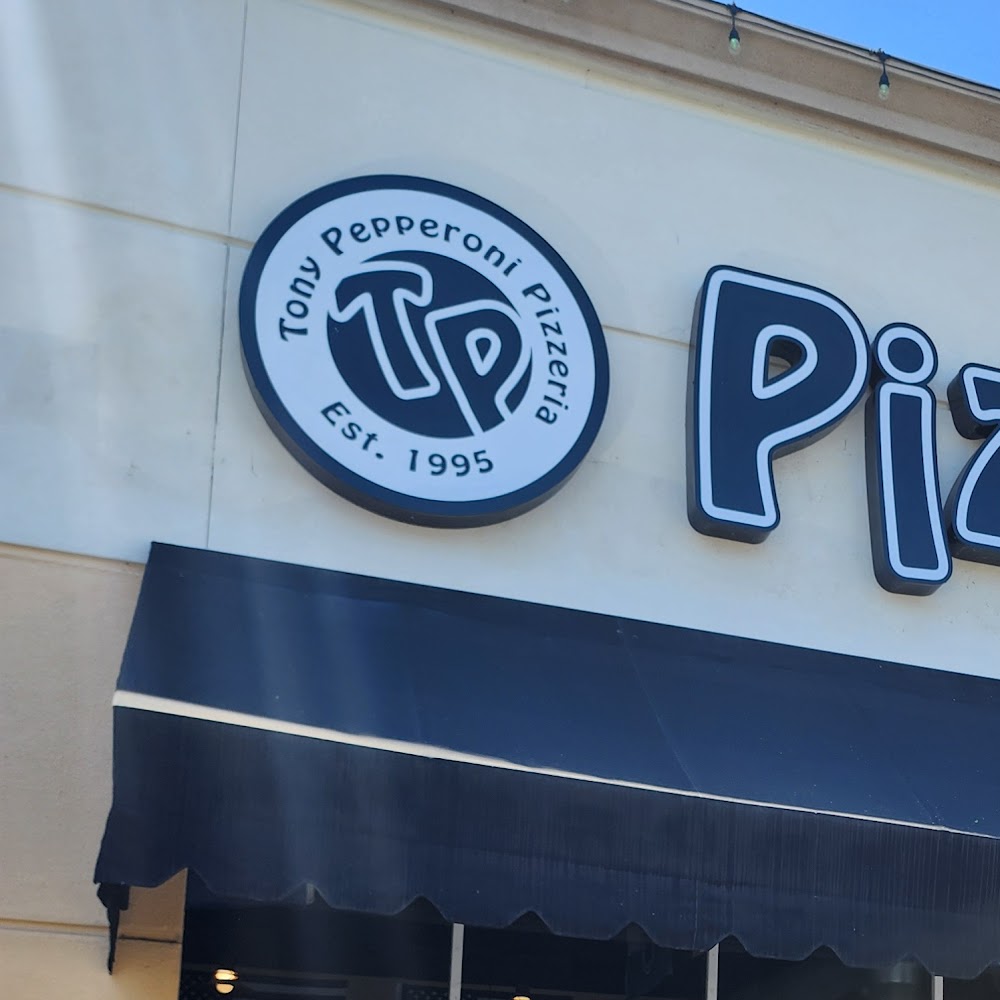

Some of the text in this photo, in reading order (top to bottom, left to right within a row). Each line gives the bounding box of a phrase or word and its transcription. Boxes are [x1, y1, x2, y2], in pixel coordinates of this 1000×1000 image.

[277, 214, 570, 426] Tony Pepperoni Pizzeria
[319, 401, 494, 477] Est. 1995
